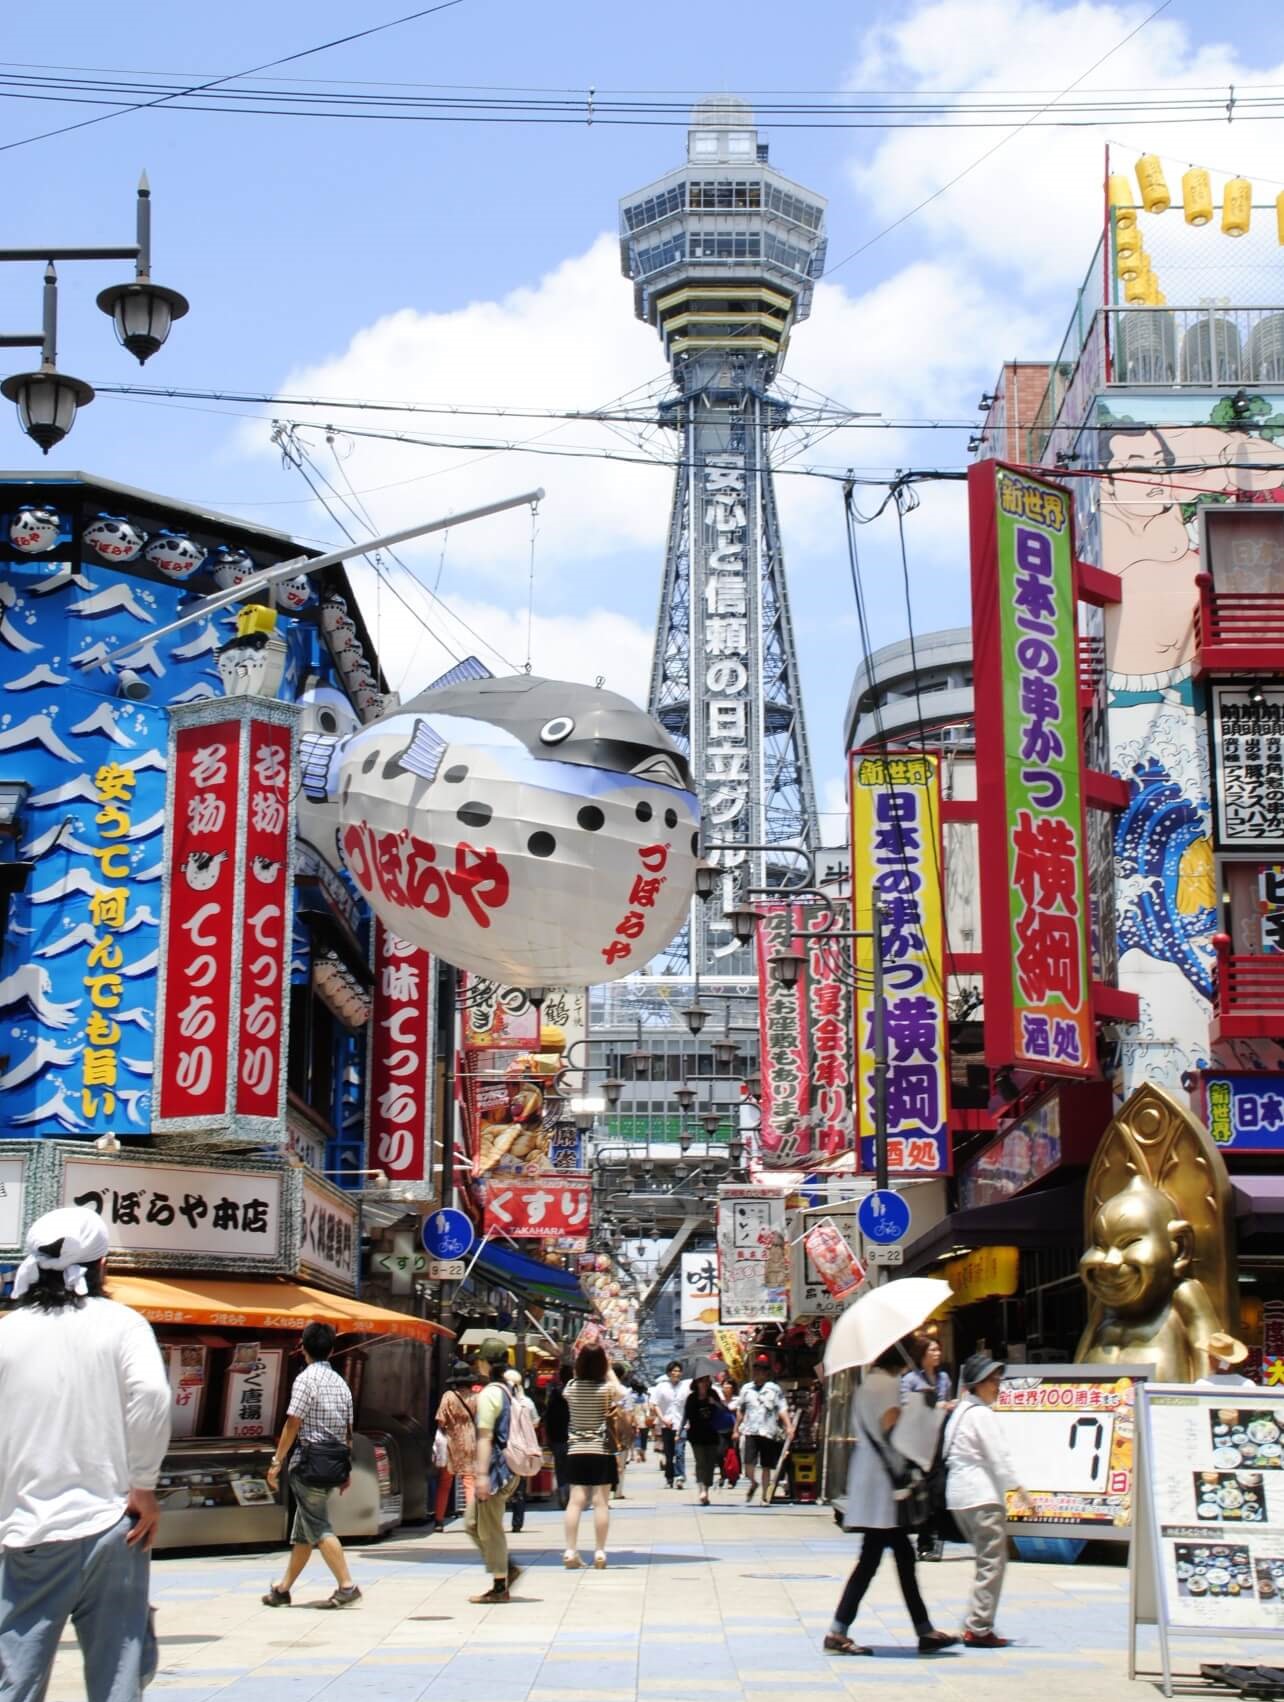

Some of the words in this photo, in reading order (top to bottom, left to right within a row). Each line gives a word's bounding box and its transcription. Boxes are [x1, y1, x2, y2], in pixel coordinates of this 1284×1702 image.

[1000, 476, 1066, 532] 新世界
[189, 743, 227, 835] 名物
[252, 742, 286, 835] 名物
[859, 760, 933, 786] 新世界
[601, 842, 672, 965] づぼらや
[83, 763, 135, 1117] 安うて何んでも旨い
[1211, 1080, 1232, 1142] 新世界
[74, 1188, 269, 1234] づぼらや本店
[488, 1190, 588, 1224] くすり
[510, 1226, 565, 1235] TAKAHARA
[380, 1256, 426, 1270] くすり
[234, 1425, 263, 1435] 1,050
[1069, 1417, 1103, 1480] 7
[1112, 1472, 1127, 1492] 日
